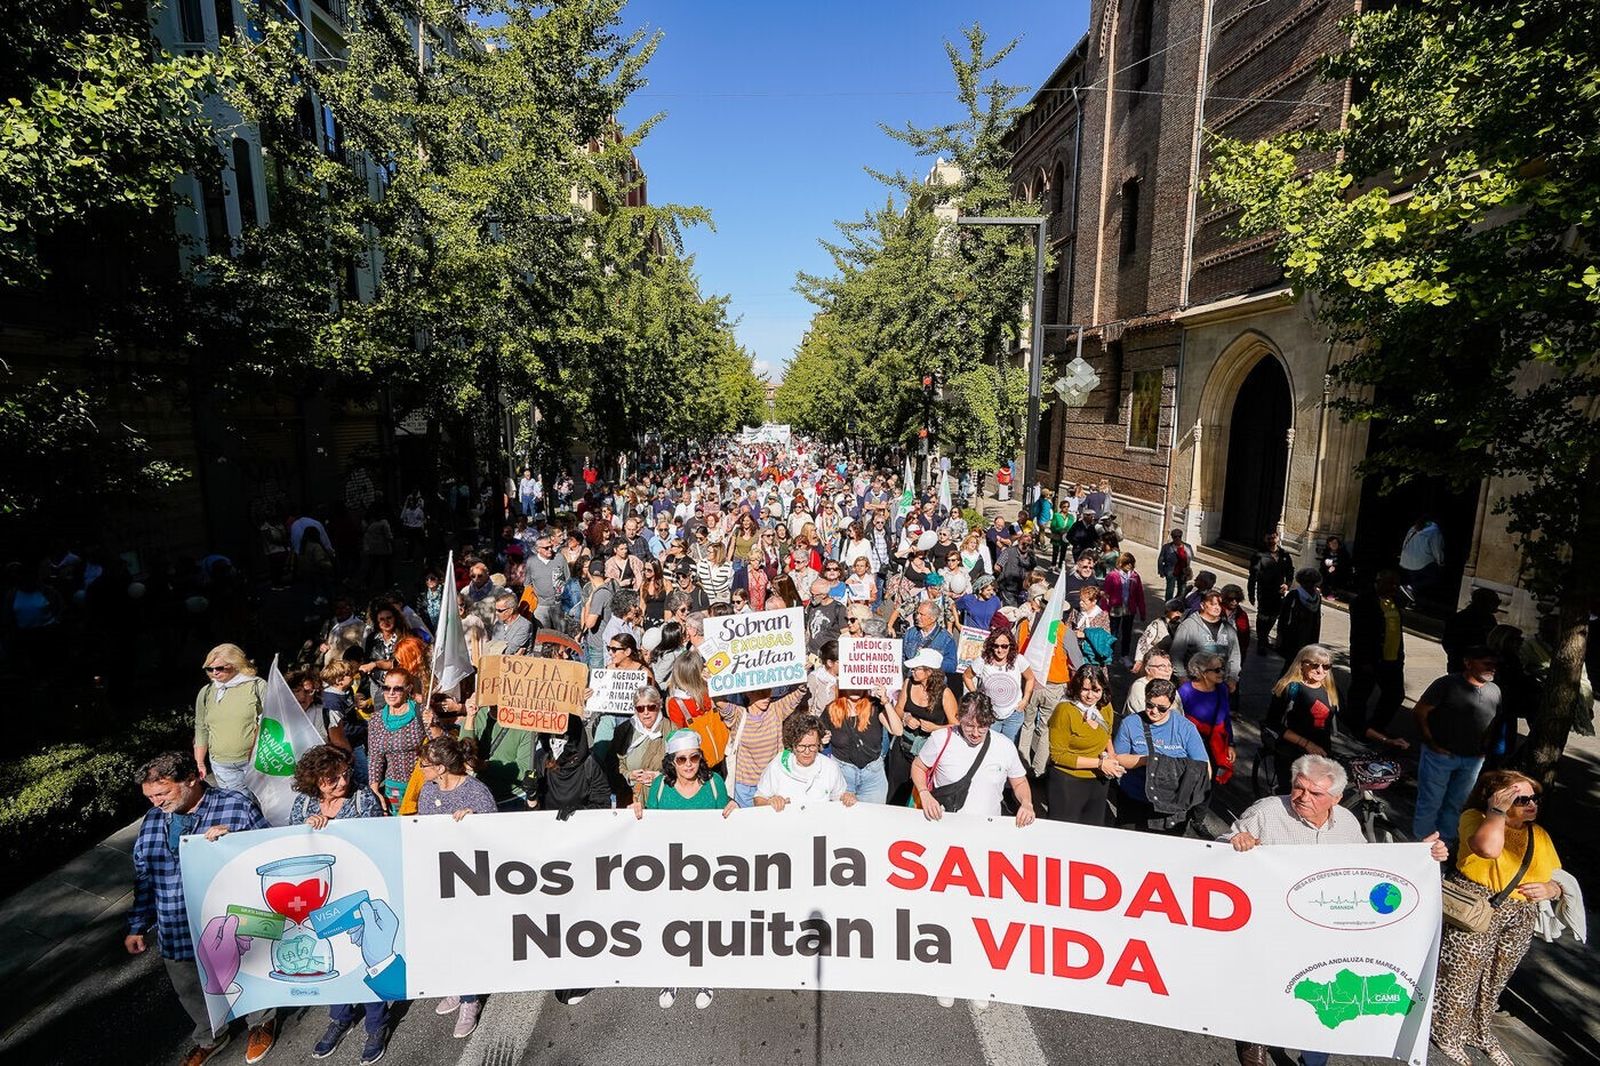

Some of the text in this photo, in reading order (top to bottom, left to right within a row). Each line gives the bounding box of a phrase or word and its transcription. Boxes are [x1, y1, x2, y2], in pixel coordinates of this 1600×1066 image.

[719, 613, 792, 643] Sobran
[731, 632, 794, 654] EXCUSAS
[502, 656, 562, 682] SOY LA
[731, 649, 796, 675] Faltan
[843, 663, 900, 675] TAMBIÉN ESTÁN
[848, 652, 896, 663] LUCHANDO,
[612, 672, 646, 681] AGENDAS
[711, 662, 805, 692] CONTRATOS
[498, 707, 568, 731] OS ESPERO
[262, 728, 294, 766] SANIDAD
[438, 835, 1252, 932] Nos roban la SANIDAD
[315, 907, 341, 922] VISA
[512, 908, 1170, 997] Nos quitan la VIDA
[1284, 960, 1328, 995] COORDINADORA
[1328, 956, 1364, 966] ANDALUZA
[1375, 959, 1401, 974] MAREAS
[1400, 969, 1426, 1002] BLANCAS
[1375, 994, 1401, 1002] CAMB
